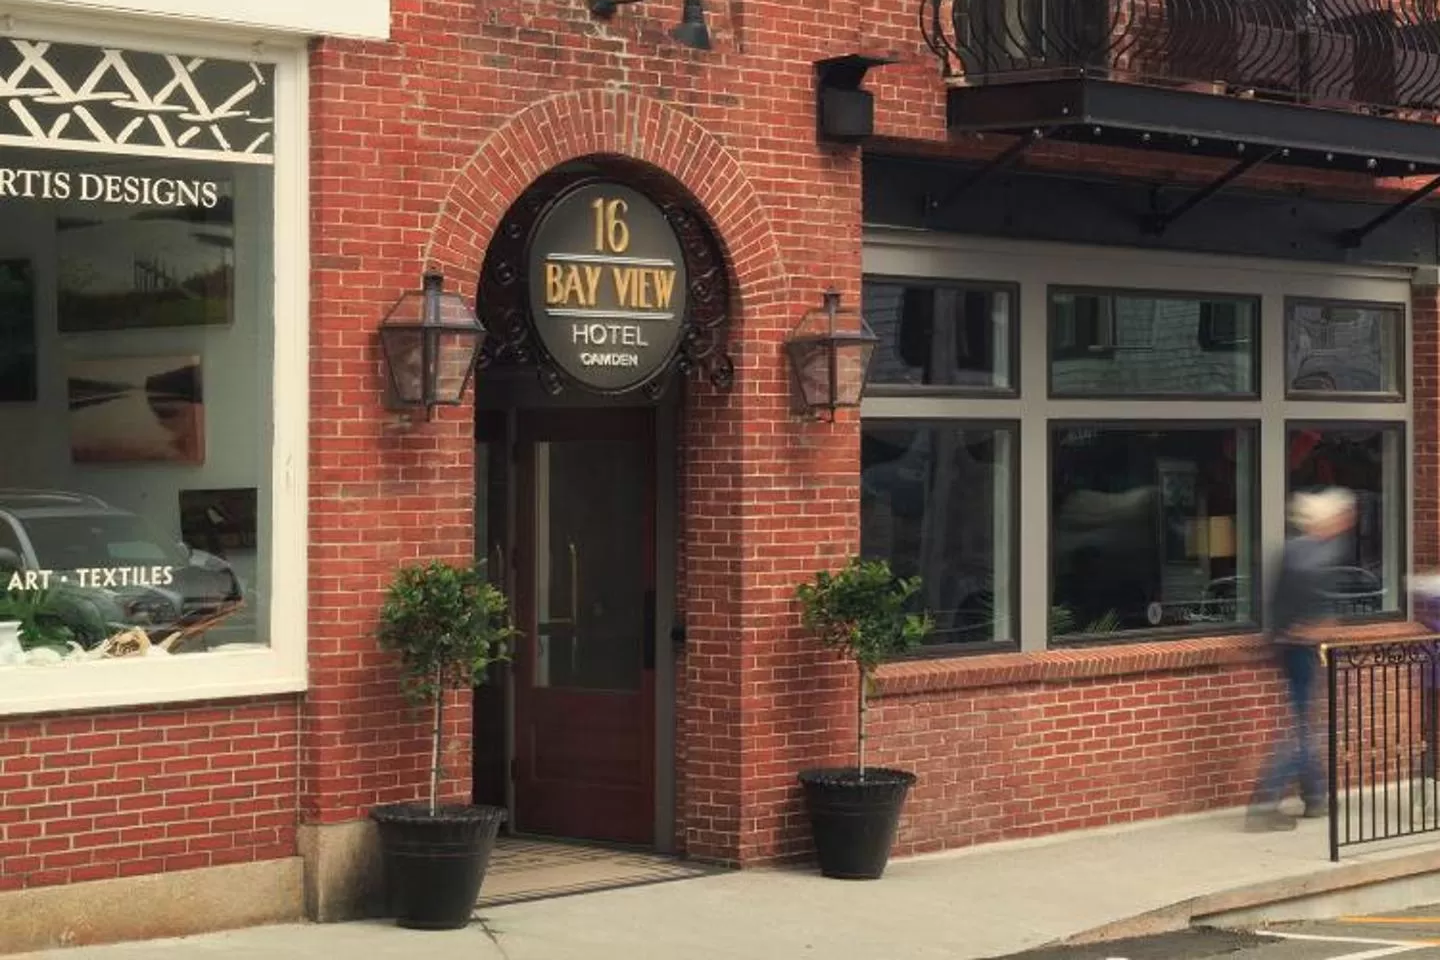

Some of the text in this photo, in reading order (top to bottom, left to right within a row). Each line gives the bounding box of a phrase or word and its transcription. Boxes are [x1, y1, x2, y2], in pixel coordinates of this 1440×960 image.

[0, 167, 219, 209] RTIS DESIGNS
[592, 197, 630, 253] 16
[545, 262, 677, 309] BAY VIEW
[572, 323, 649, 347] HOTEL
[580, 352, 639, 367] CAMDEN
[7, 565, 174, 591] ART TEXTILES
